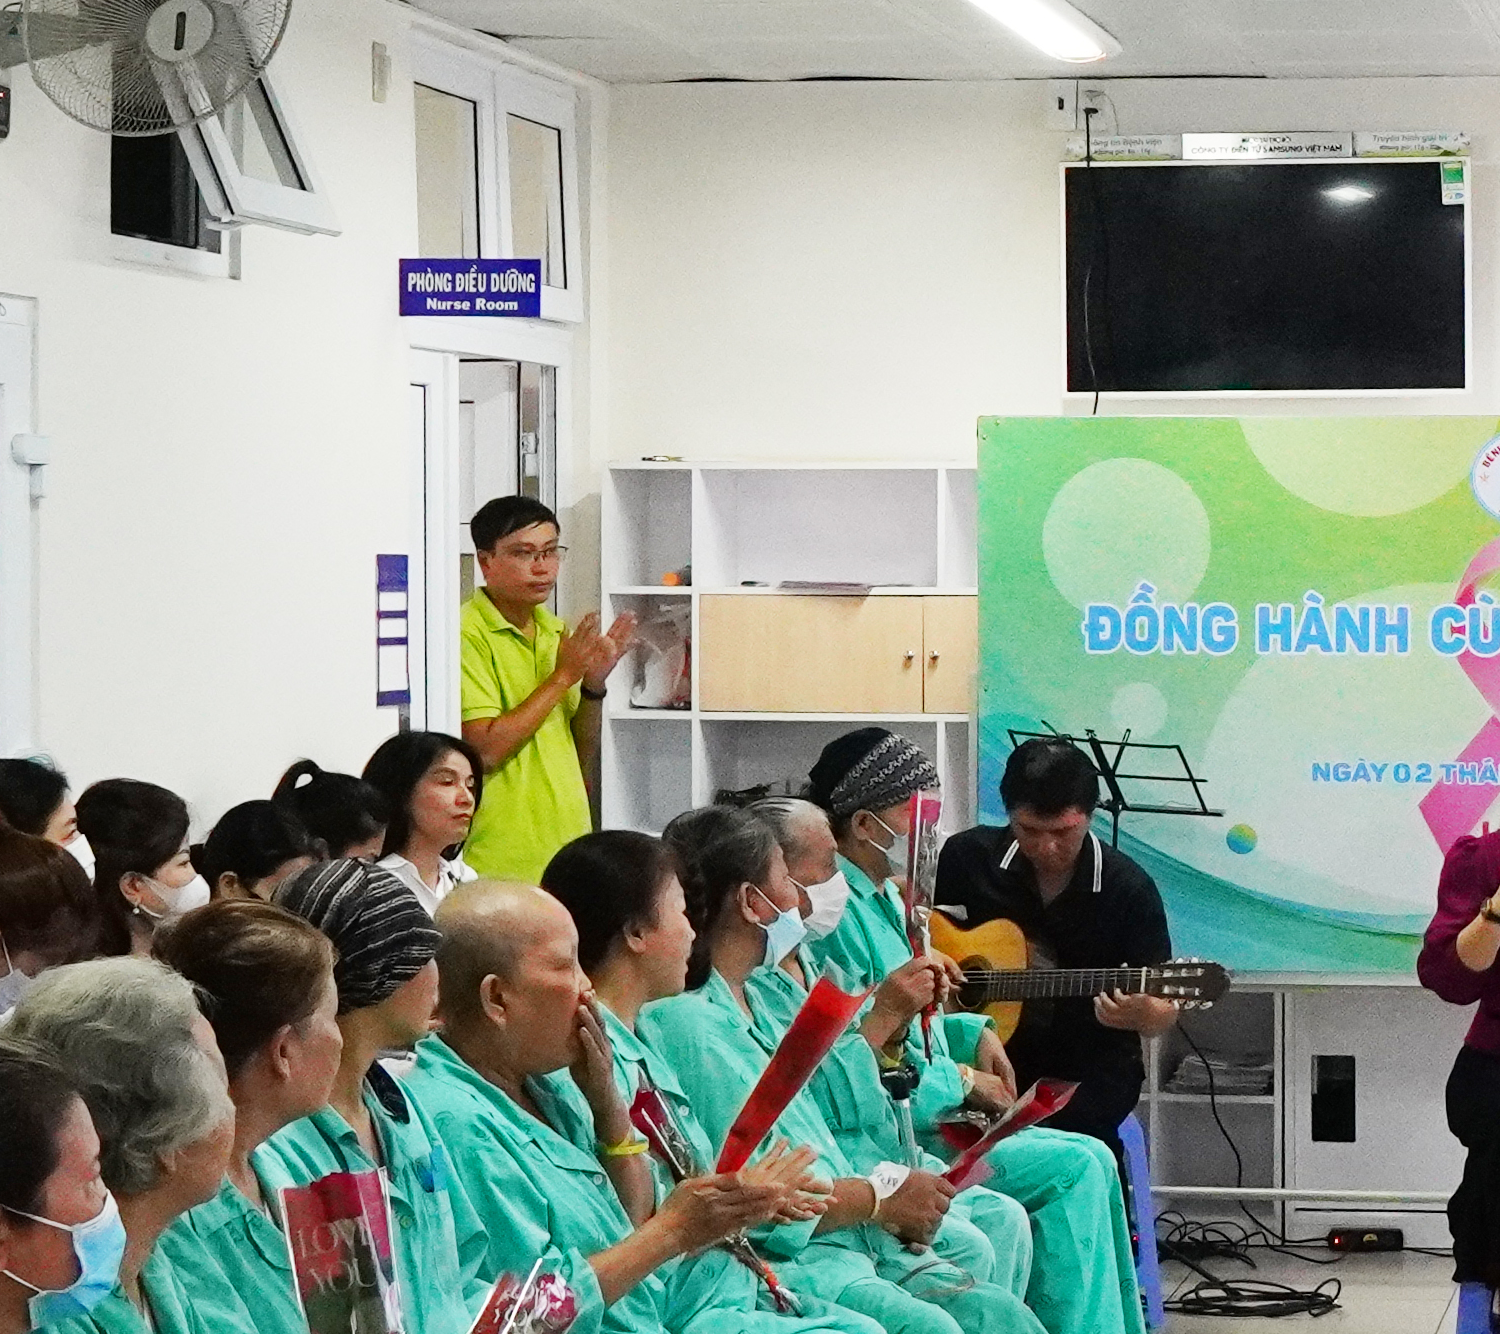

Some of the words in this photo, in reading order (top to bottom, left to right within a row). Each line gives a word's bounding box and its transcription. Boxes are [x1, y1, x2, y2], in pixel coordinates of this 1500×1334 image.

[1218, 146, 1229, 154] TY
[1262, 145, 1303, 154] SAMSUNG
[1323, 143, 1343, 153] NAM
[407, 267, 453, 293] PHÒNG
[455, 264, 487, 293] ĐIỀU
[490, 268, 536, 293] DƯỠNG
[426, 297, 471, 310] Nurse
[475, 297, 519, 311] Room
[1084, 581, 1238, 654] ĐỒNG
[1256, 589, 1411, 655] HÀNH
[1311, 760, 1389, 784] NGÀY
[1392, 761, 1432, 784] 02
